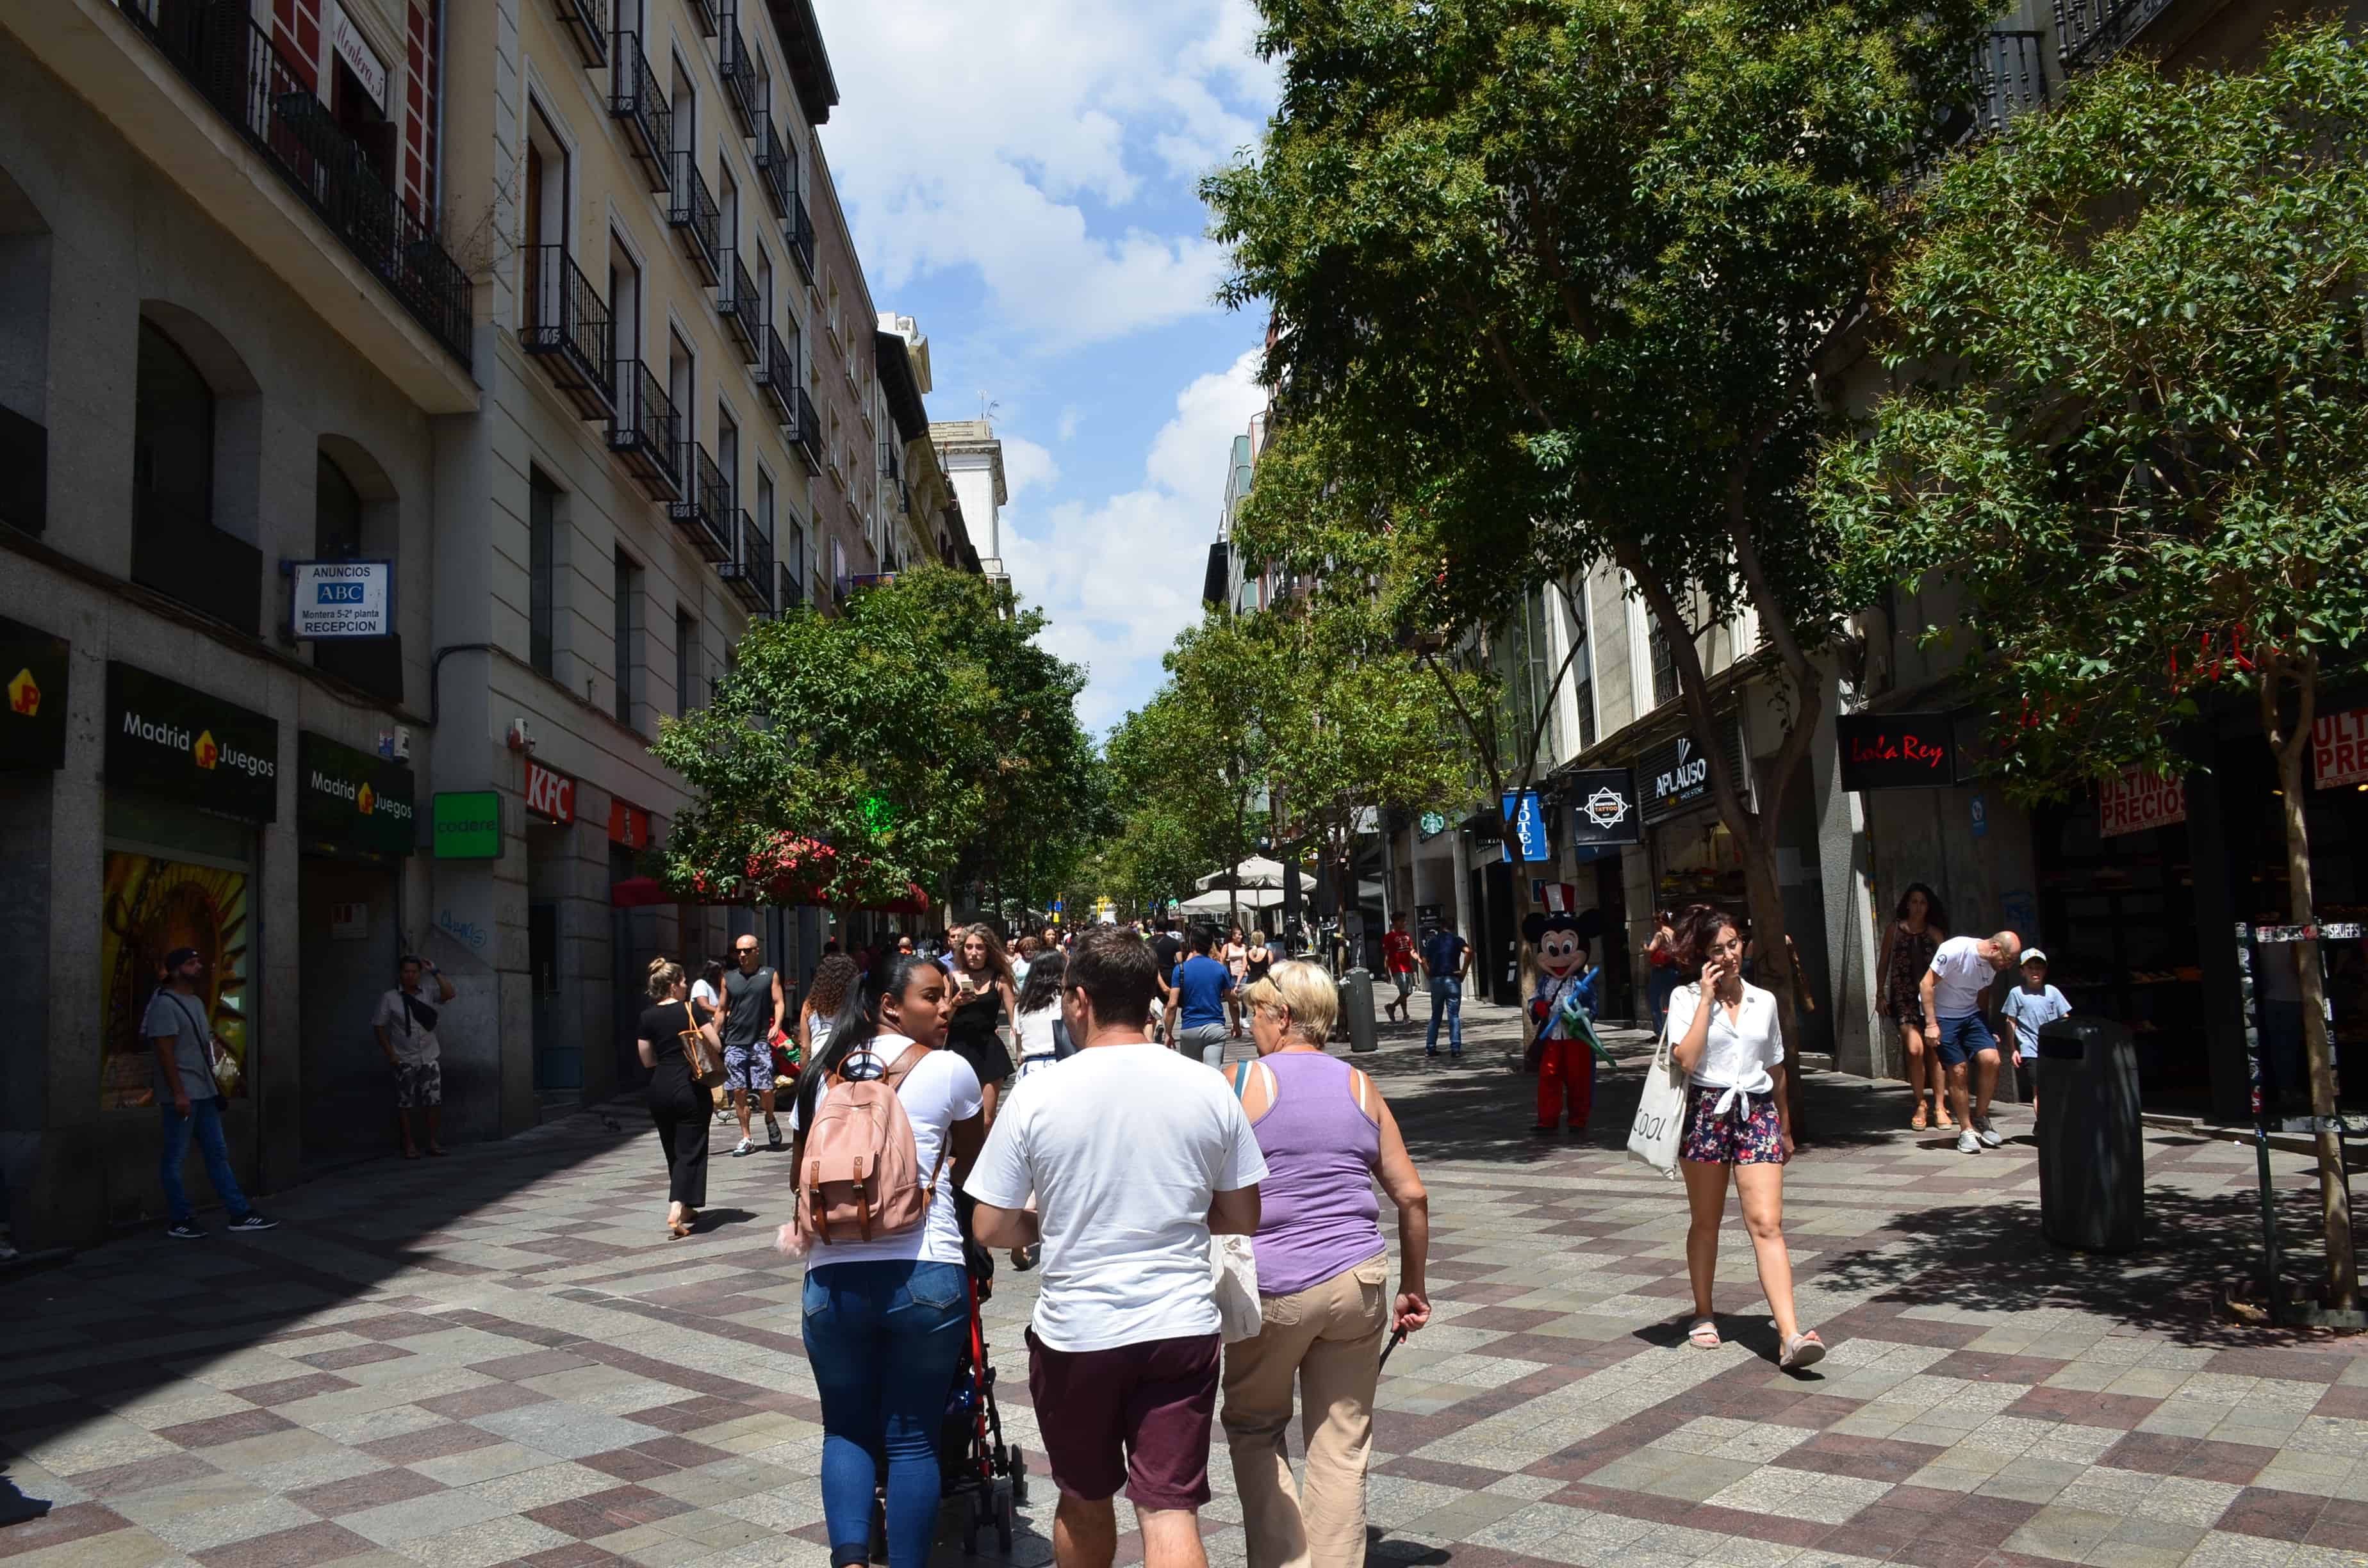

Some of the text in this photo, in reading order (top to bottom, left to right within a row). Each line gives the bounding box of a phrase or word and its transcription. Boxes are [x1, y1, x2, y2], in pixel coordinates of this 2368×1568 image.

[313, 567, 370, 577] ANUNCIOS
[320, 585, 361, 600] ABC
[302, 610, 334, 619] Montera
[354, 609, 379, 619] planta
[305, 621, 376, 632] RECEPCION
[123, 712, 190, 752] Madrid
[219, 743, 274, 777] Juegos
[1850, 733, 1943, 769] Lola Rey
[1656, 758, 1706, 798] APLAUSO
[311, 770, 356, 800] Madrid
[374, 792, 413, 819] Juegos
[527, 764, 570, 820] KFC
[438, 817, 498, 833] codere
